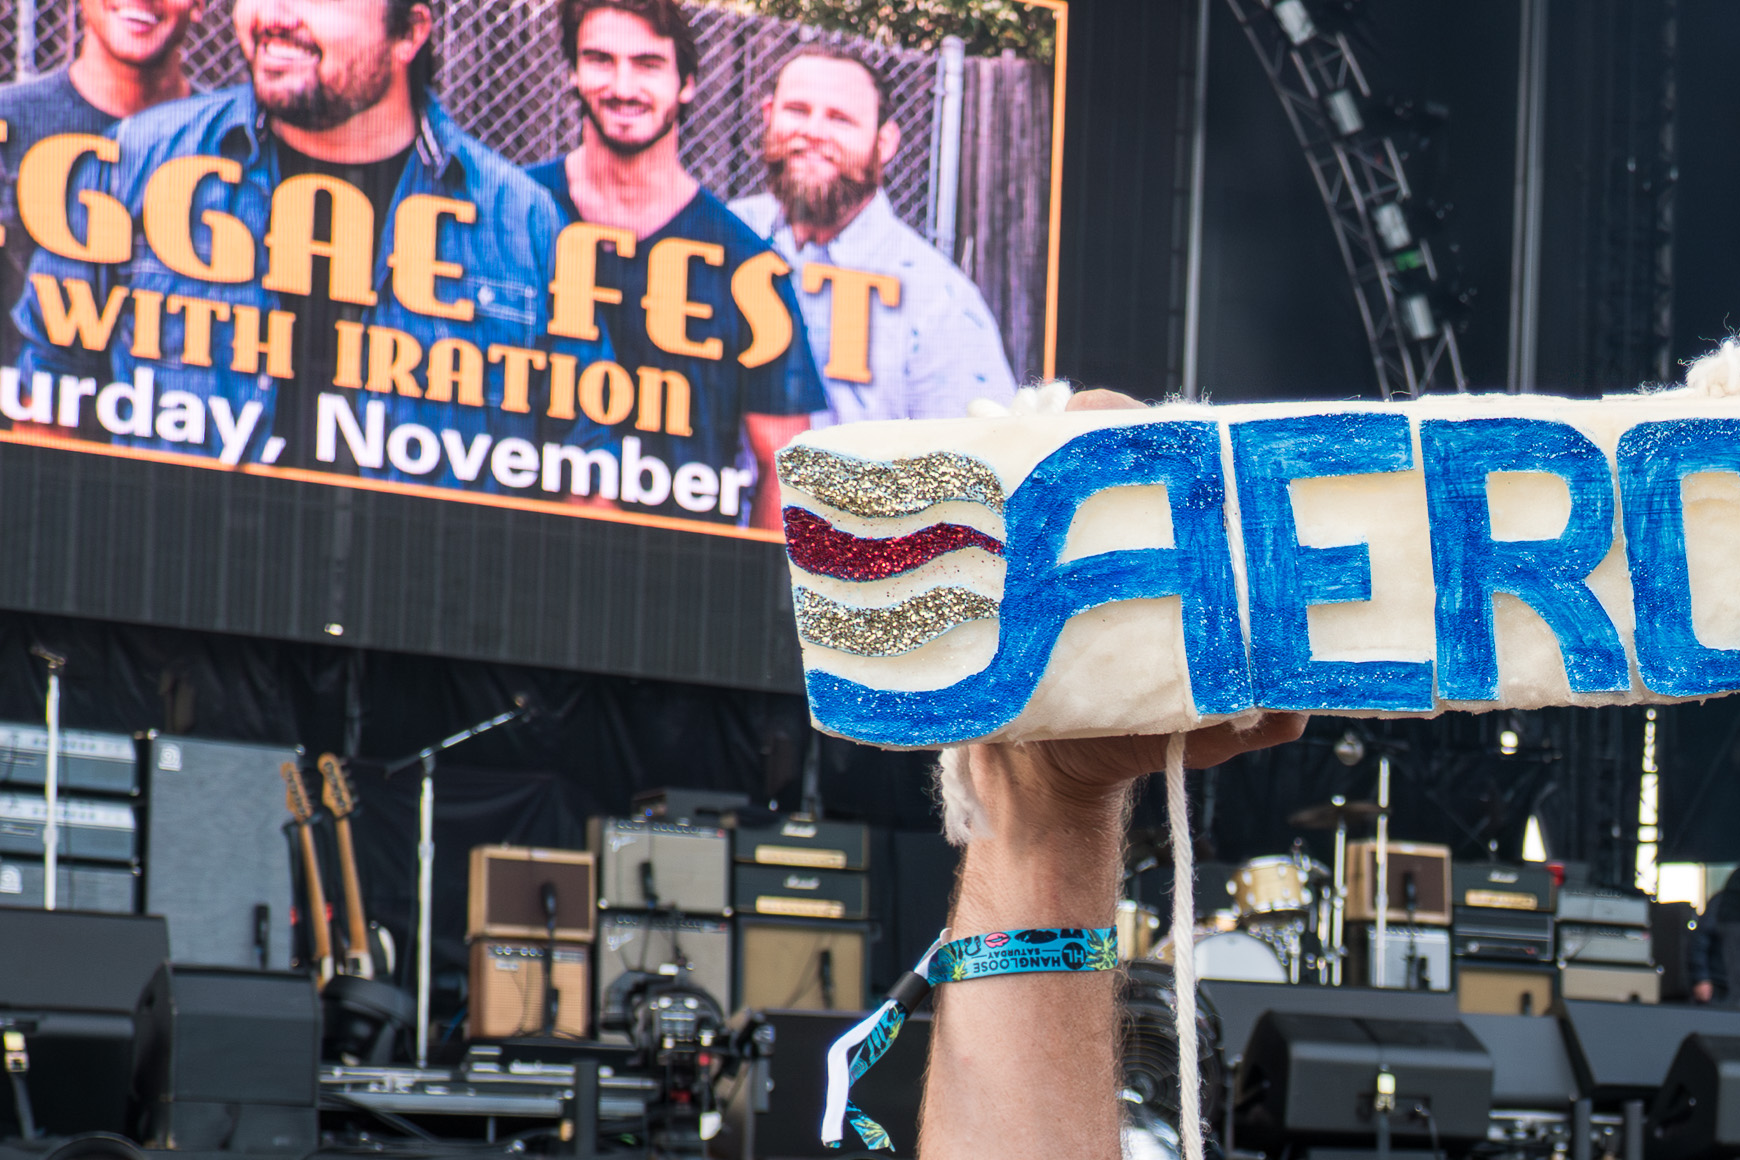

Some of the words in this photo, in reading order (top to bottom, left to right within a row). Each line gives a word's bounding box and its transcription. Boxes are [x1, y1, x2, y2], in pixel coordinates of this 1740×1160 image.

[0, 120, 477, 322] GGAE
[546, 221, 902, 384] FEST
[30, 272, 295, 379] WITH
[334, 319, 693, 437] IRATION
[315, 393, 753, 516] November
[973, 956, 1061, 974] HANGLOOSE
[987, 948, 1041, 959] SATURDAY
